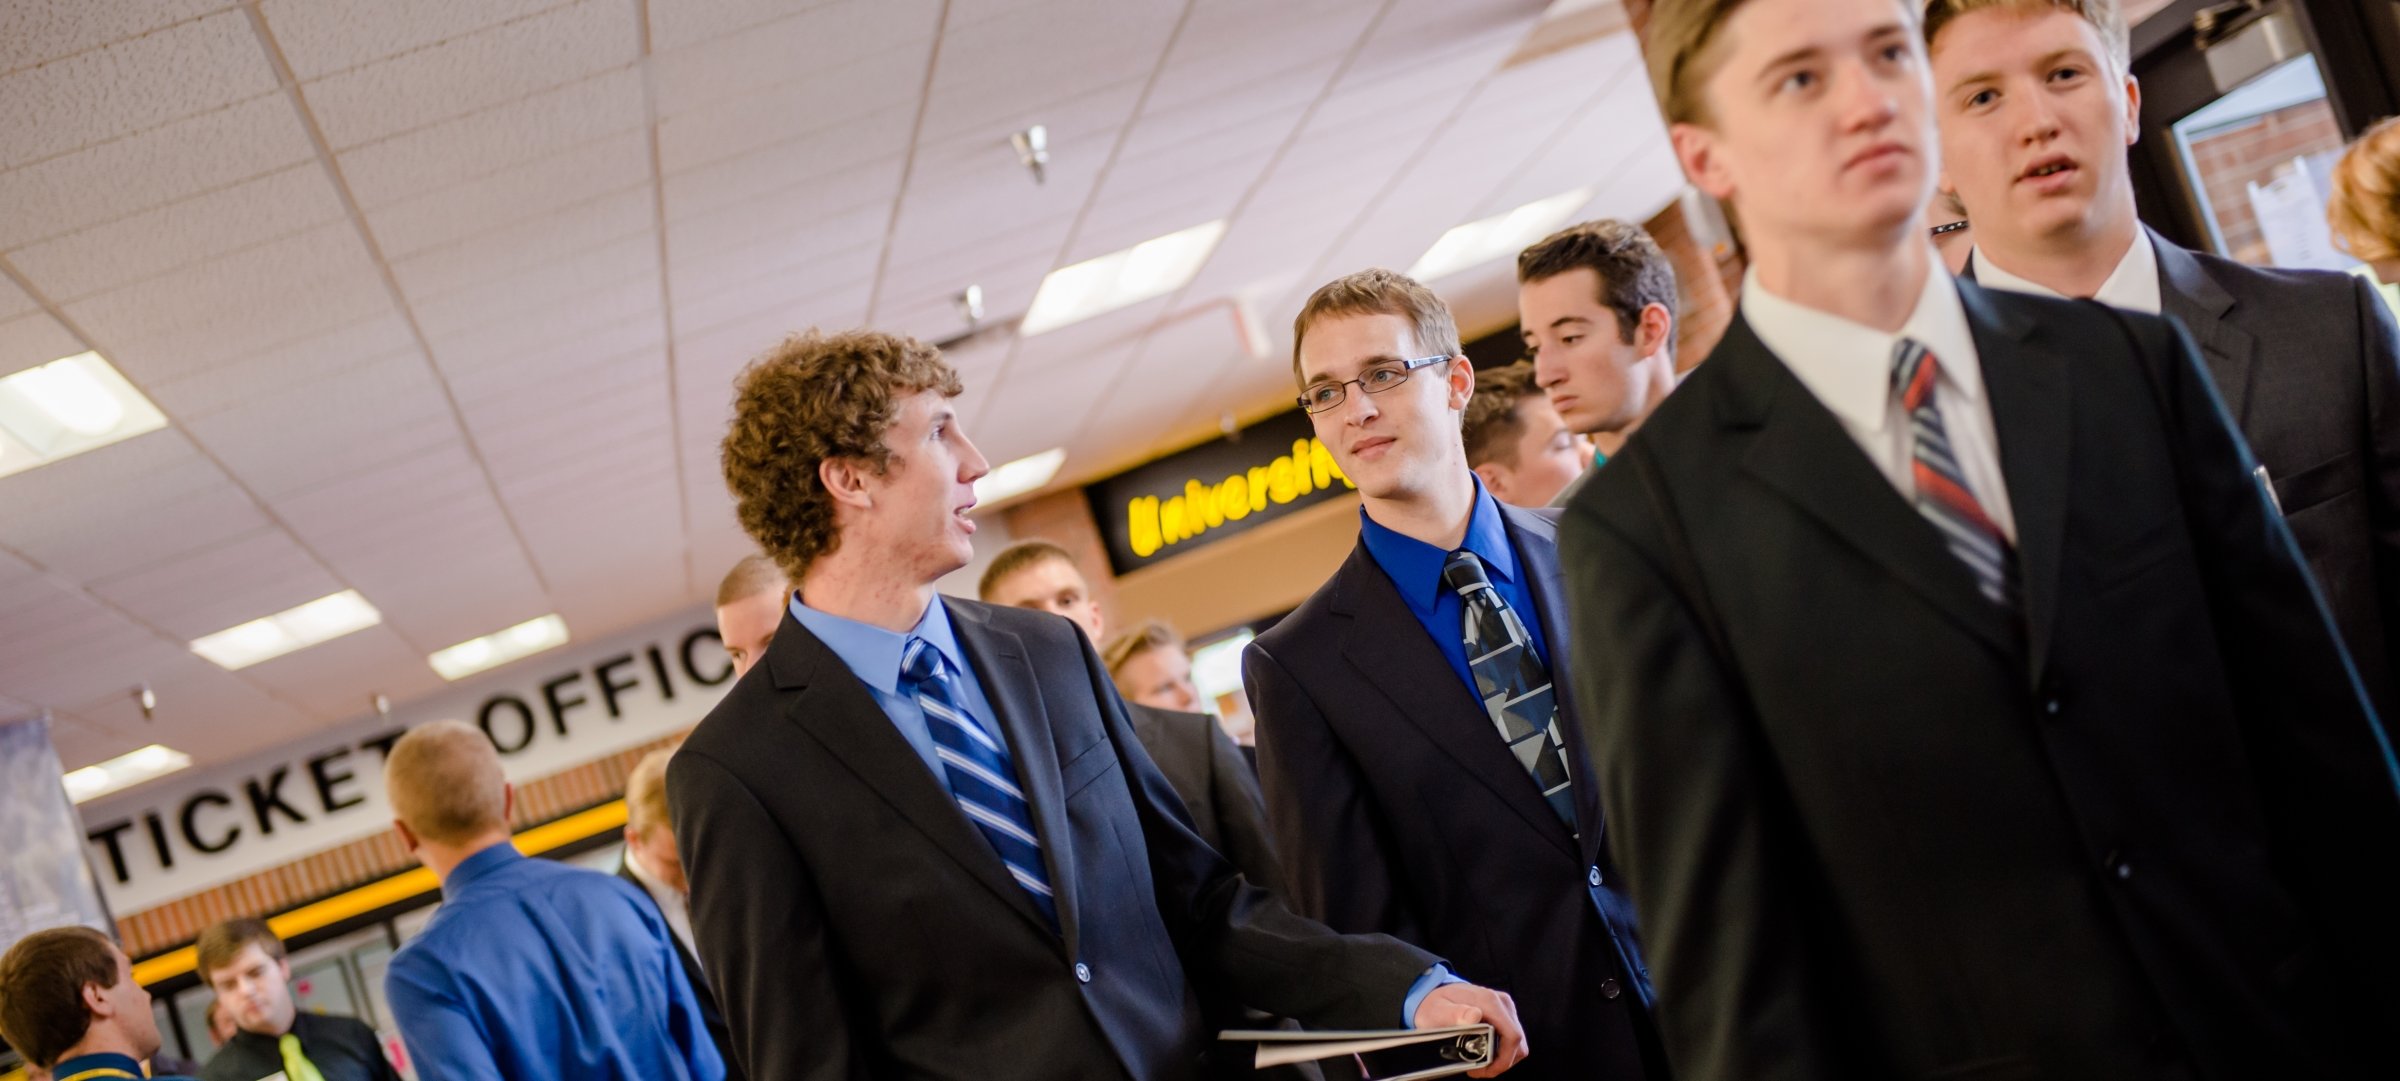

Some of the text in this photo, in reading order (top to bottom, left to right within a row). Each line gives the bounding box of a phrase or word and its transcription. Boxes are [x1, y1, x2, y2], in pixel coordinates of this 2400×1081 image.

[1128, 437, 1356, 557] Universit
[89, 627, 736, 883] TICKET OFFIC
